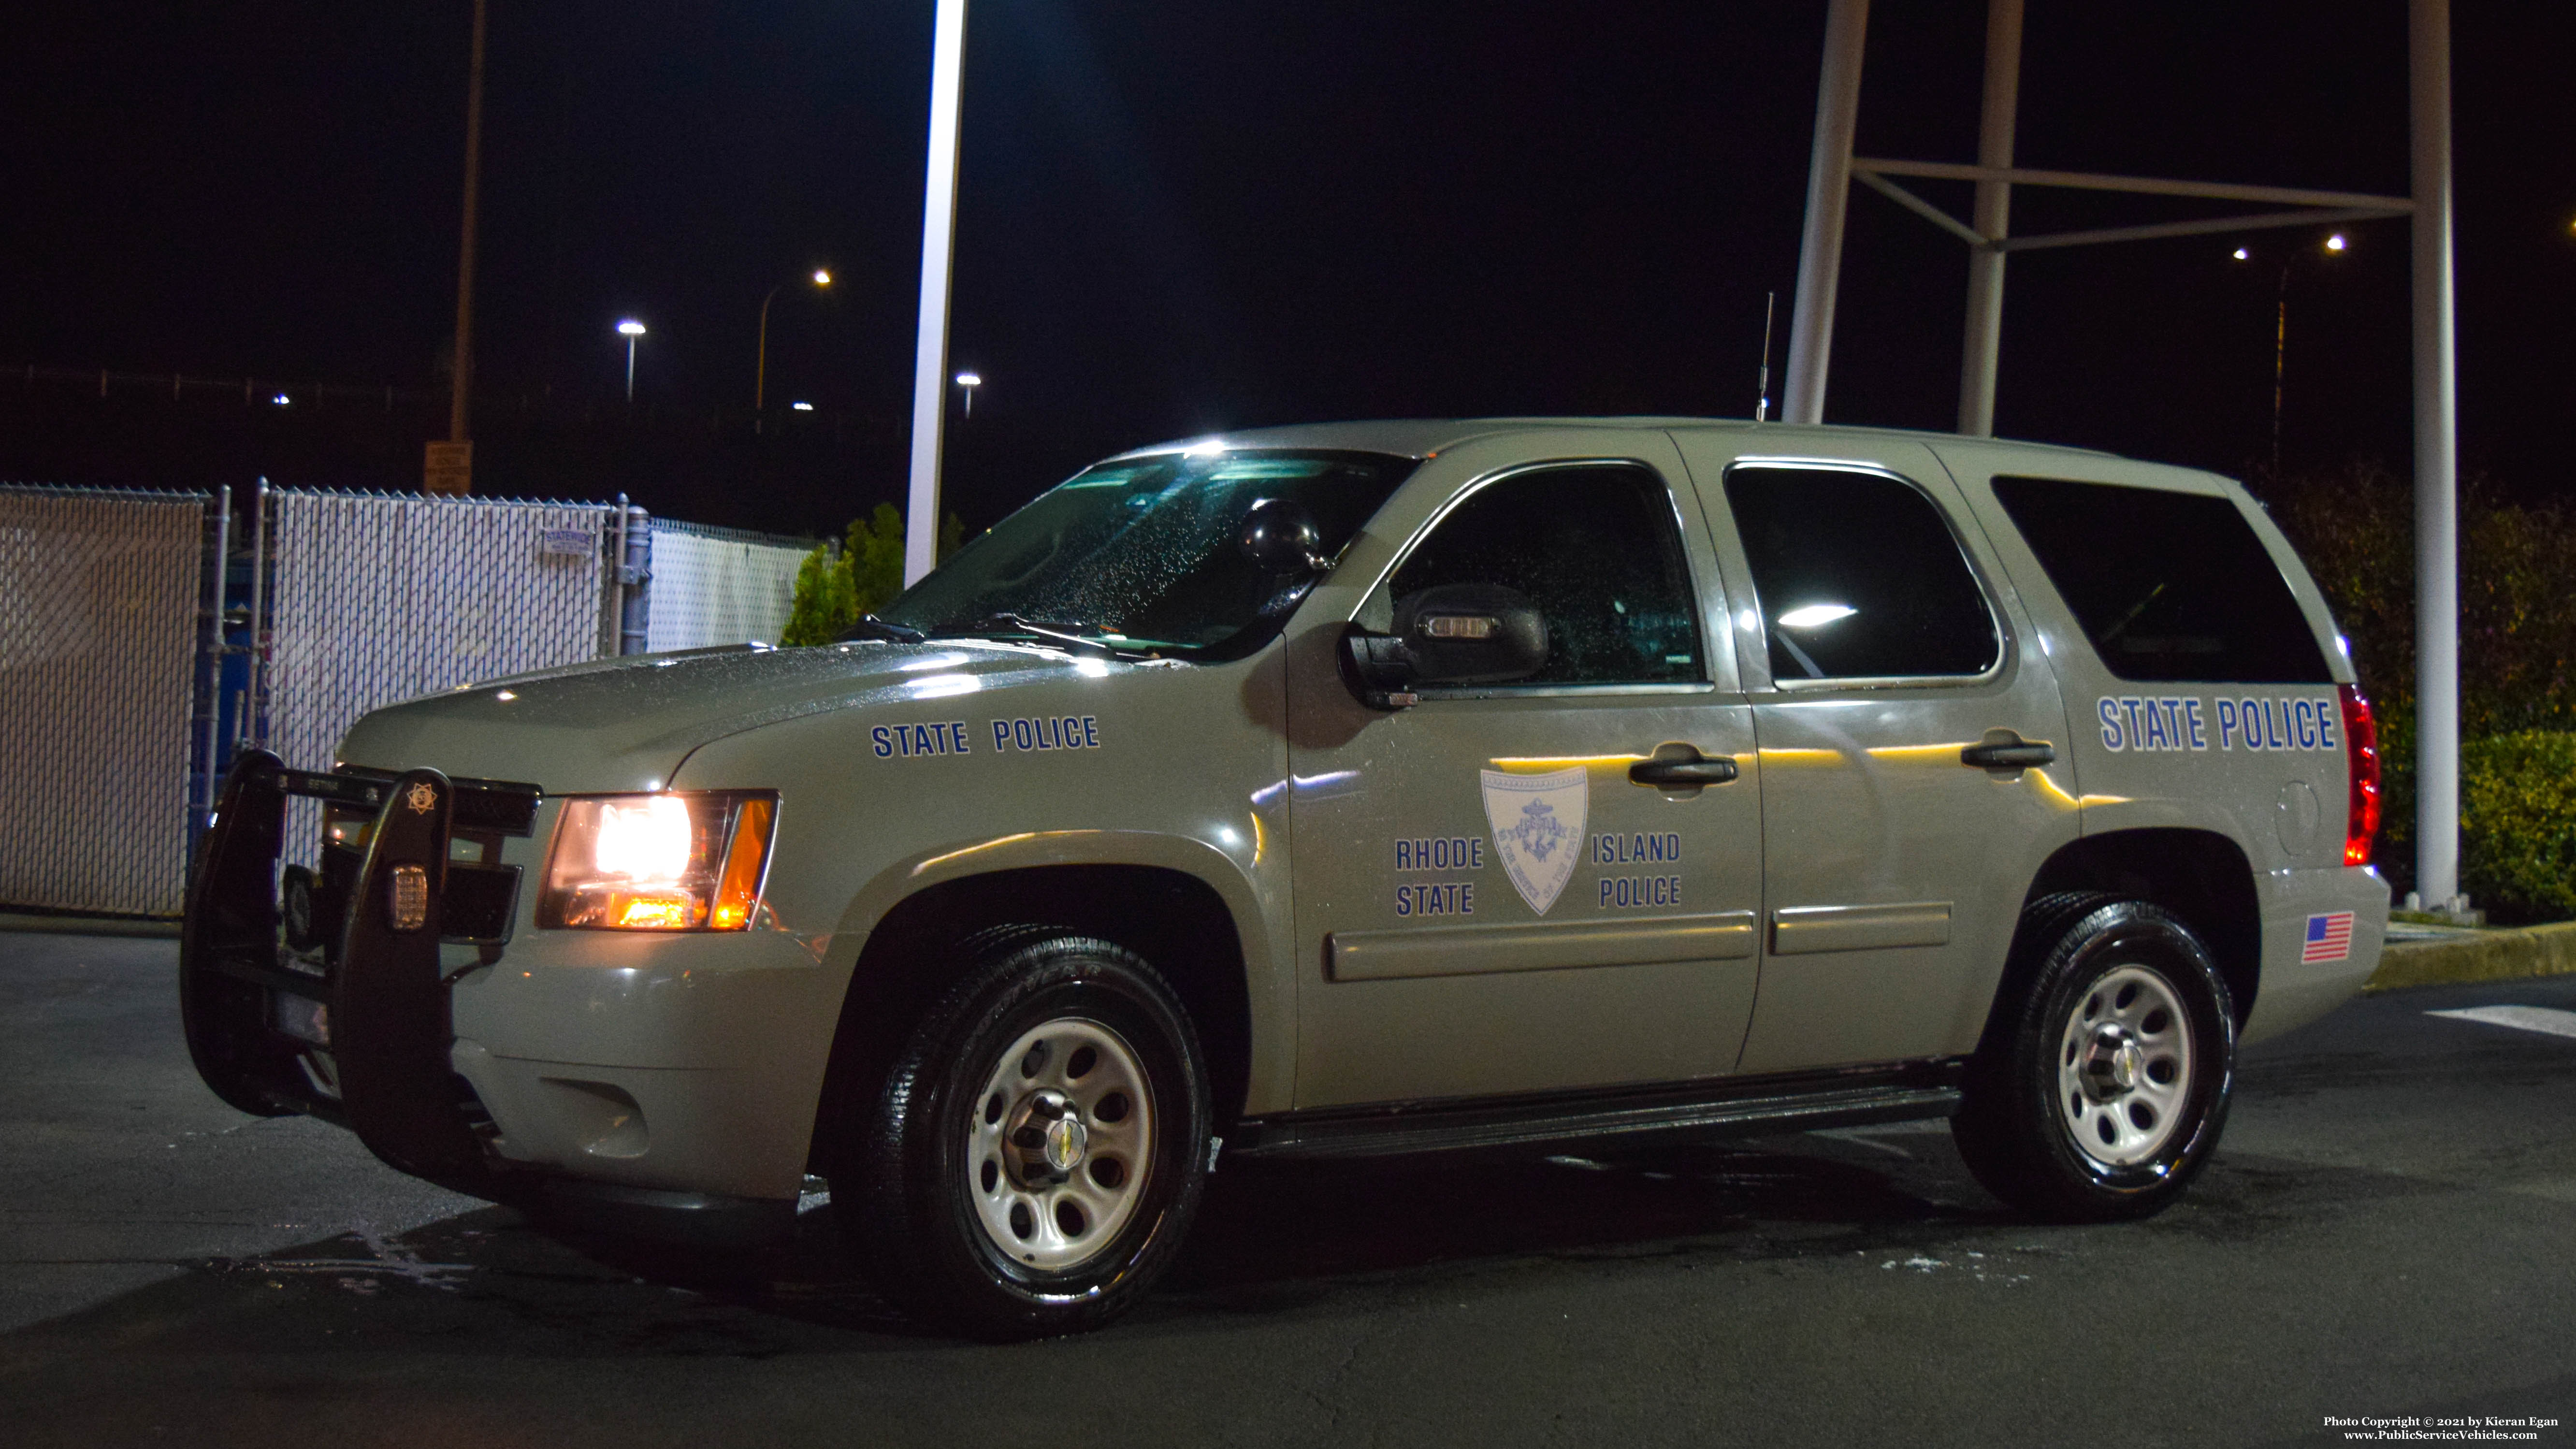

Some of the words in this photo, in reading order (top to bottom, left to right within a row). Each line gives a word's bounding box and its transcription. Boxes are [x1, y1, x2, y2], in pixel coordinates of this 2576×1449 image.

[872, 722, 970, 759] STATE
[990, 715, 1100, 753] POLICE
[2097, 696, 2208, 752] STATE
[2215, 696, 2337, 752] POLICE
[1395, 837, 1483, 870] RHODE
[1592, 833, 1680, 864] ISLAND
[1396, 882, 1474, 917] STATE
[1599, 875, 1681, 909] POLICE
